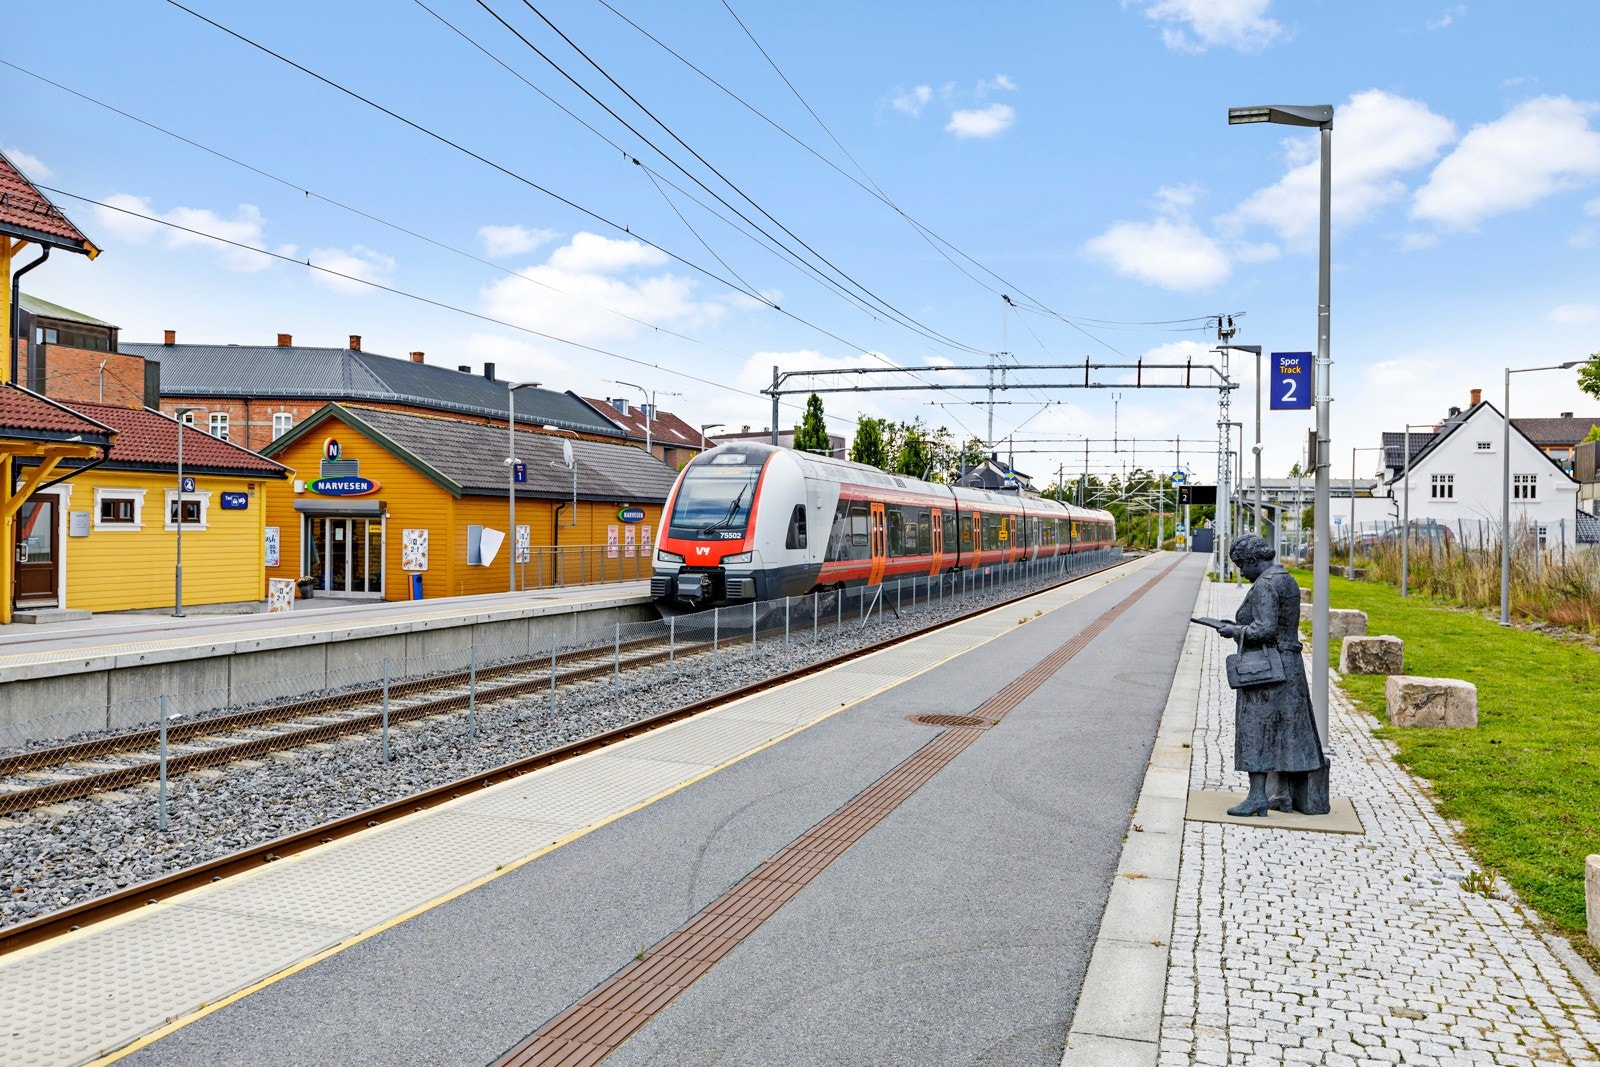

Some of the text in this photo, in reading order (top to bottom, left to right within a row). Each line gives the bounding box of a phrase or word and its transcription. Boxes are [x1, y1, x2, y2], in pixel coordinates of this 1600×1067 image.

[1280, 357, 1299, 366] Spor
[1280, 366, 1301, 374] Track
[1281, 378, 1297, 402] 2
[329, 444, 337, 456] N
[517, 472, 522, 481] 1
[318, 482, 368, 490] NARVESEN
[1182, 494, 1188, 502] 2
